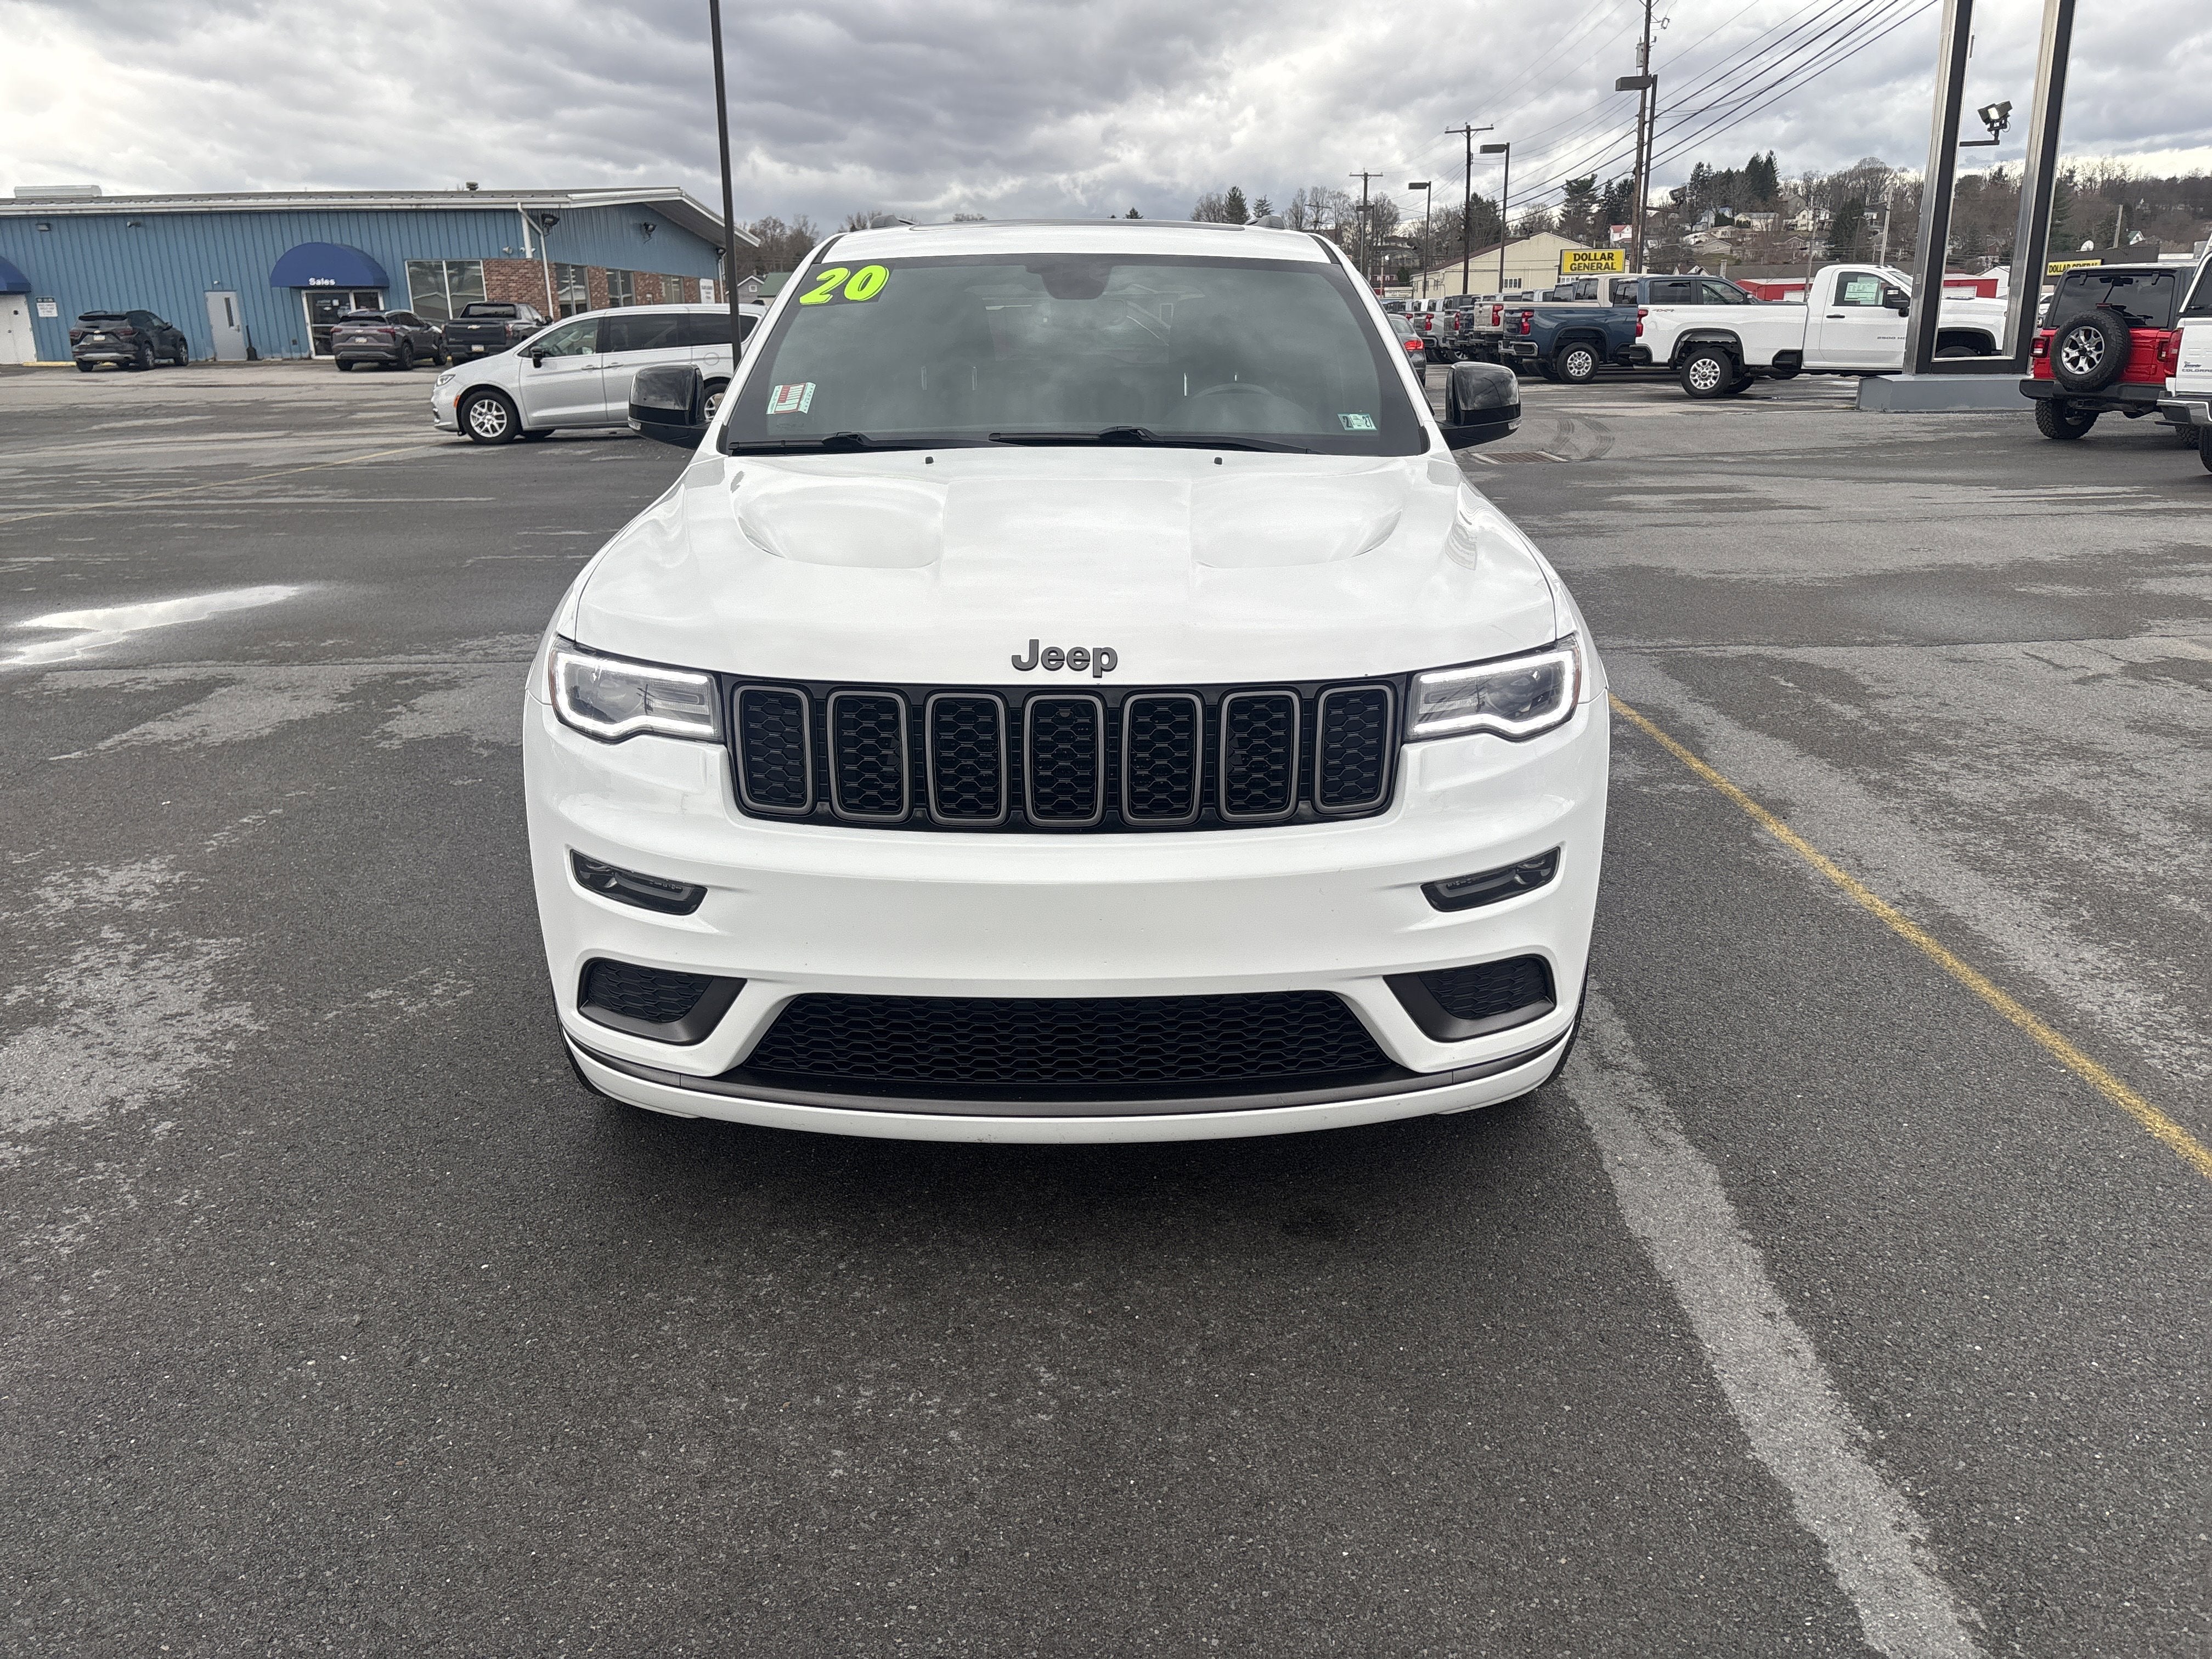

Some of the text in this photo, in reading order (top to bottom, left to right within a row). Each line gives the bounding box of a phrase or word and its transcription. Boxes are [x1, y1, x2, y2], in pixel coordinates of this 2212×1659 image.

[1573, 252, 1615, 262] DOLLAR
[1570, 262, 1617, 272] GENERAL
[308, 277, 335, 286] Sales
[799, 264, 890, 305] 20
[1362, 416, 1373, 428] 27
[1011, 639, 1119, 679] Jeep
